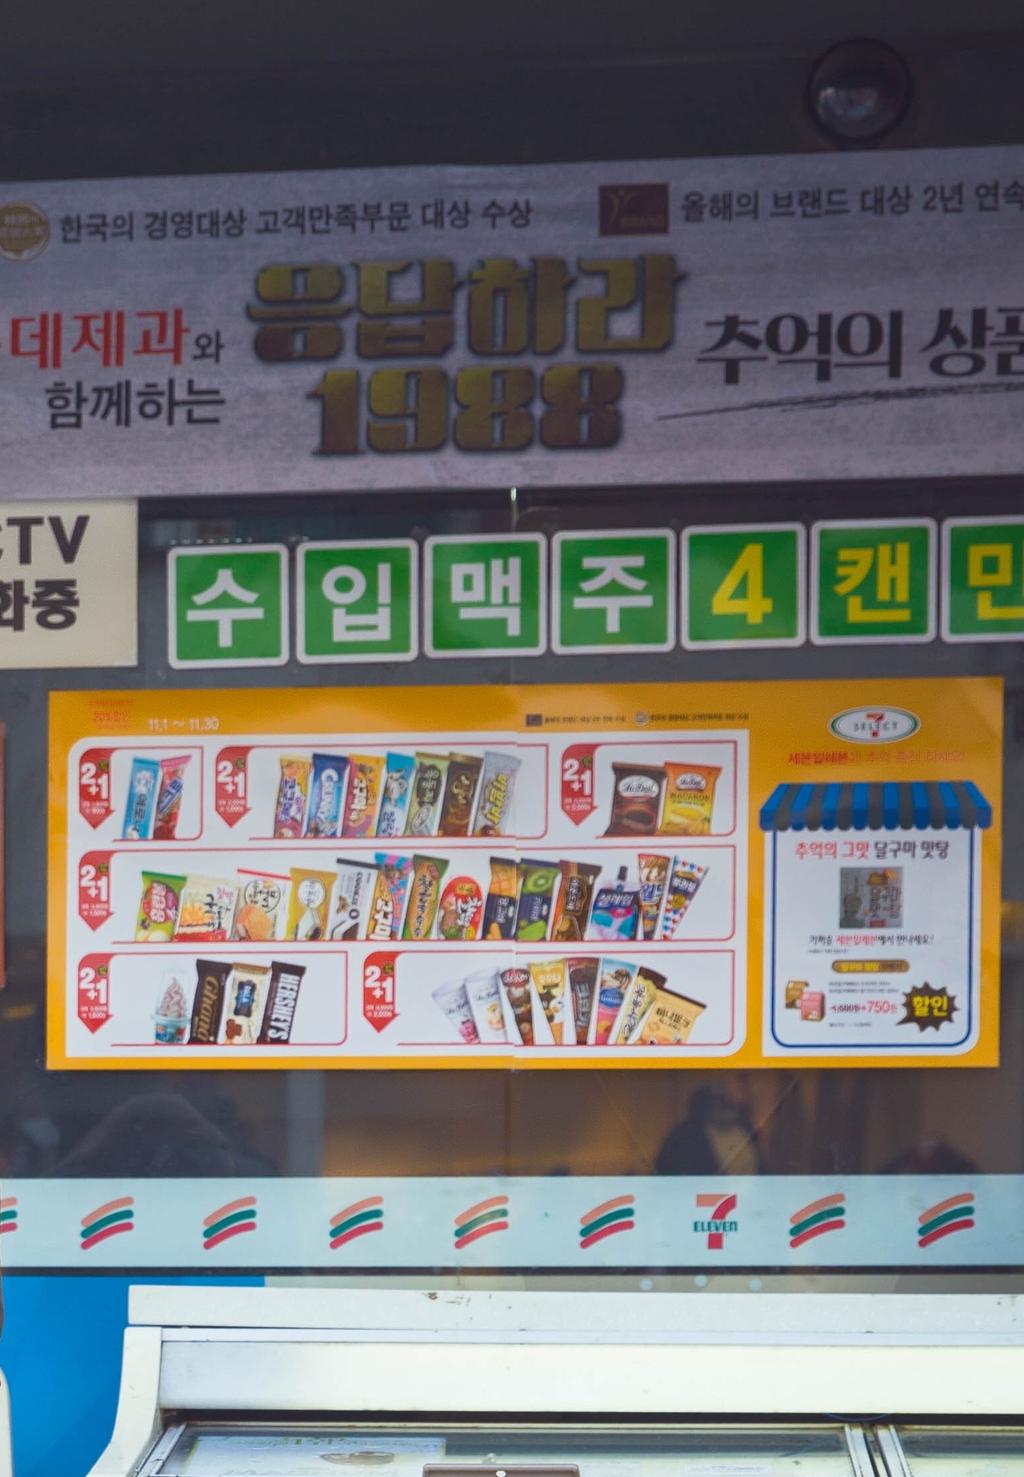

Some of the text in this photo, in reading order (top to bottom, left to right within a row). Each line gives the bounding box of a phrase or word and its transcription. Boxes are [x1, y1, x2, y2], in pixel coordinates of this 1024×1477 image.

[59, 211, 134, 243] 한국의
[144, 207, 247, 241] 경영대상
[254, 202, 412, 237] 고객만족부문
[422, 199, 473, 229] 대상
[480, 199, 533, 229] 수상
[680, 190, 760, 223] 올해의
[769, 186, 851, 219] 브랜드
[860, 183, 913, 216] 대상
[922, 180, 965, 213] 2년
[245, 253, 689, 365] 응답하라
[696, 310, 904, 385] 추억의
[45, 379, 226, 429] 함께하는
[306, 362, 626, 458] 1988
[196, 975, 220, 1044] Ghana
[911, 994, 948, 1018] 할인
